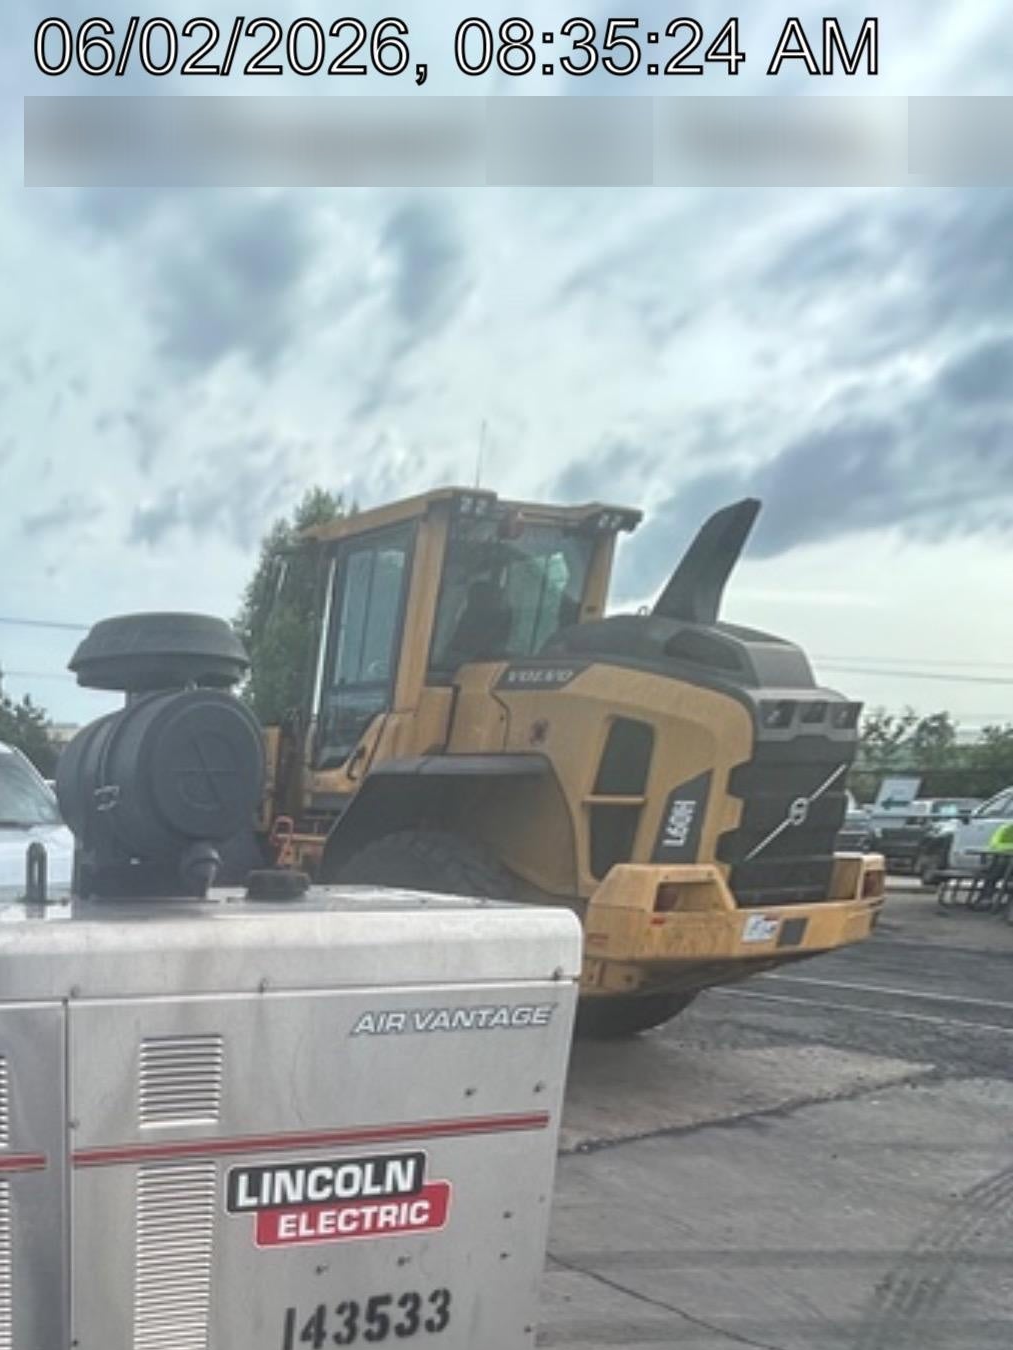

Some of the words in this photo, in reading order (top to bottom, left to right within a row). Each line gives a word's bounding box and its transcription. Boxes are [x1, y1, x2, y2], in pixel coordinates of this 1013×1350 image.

[350, 1010, 407, 1036] AIR
[412, 1003, 556, 1034] VANTAGE
[236, 1158, 417, 1208] LINCOLN
[276, 1199, 431, 1240] ELECTRIC
